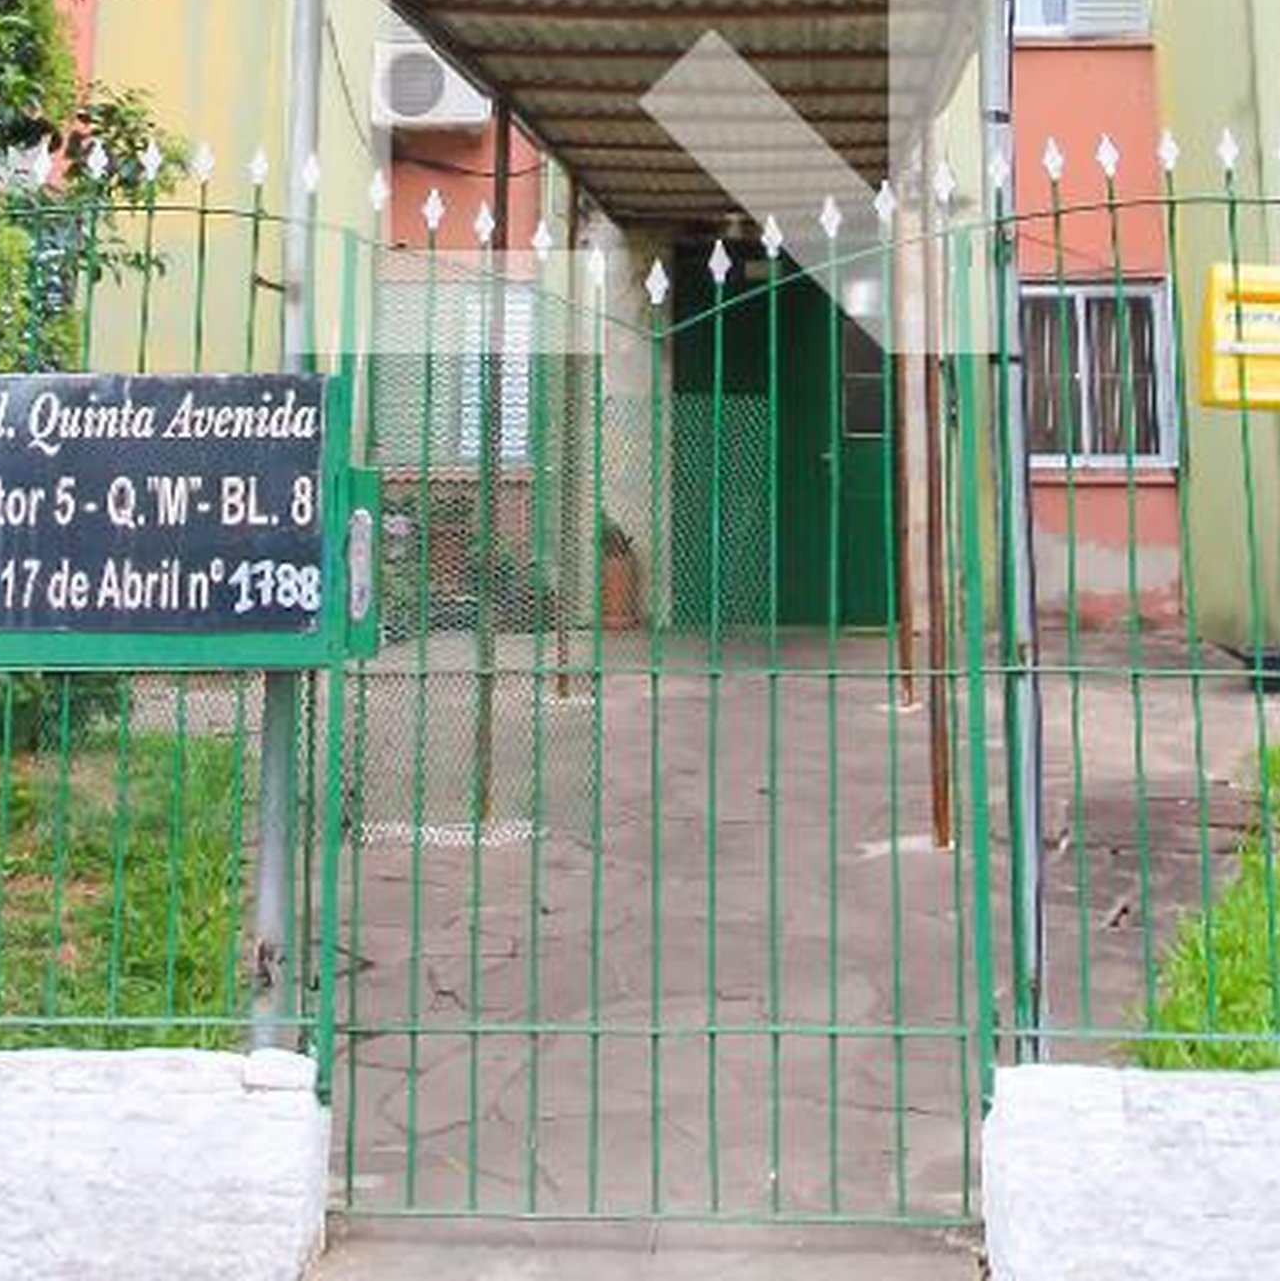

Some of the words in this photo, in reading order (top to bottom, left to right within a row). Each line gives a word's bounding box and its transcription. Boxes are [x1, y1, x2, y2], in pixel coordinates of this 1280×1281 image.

[27, 391, 157, 457] Quinta
[161, 389, 319, 439] Avenida
[53, 476, 77, 526] 5
[221, 475, 280, 526] BL.
[290, 475, 313, 526] 8
[0, 557, 42, 609] 17
[46, 556, 91, 611] de
[96, 556, 181, 610] Abril
